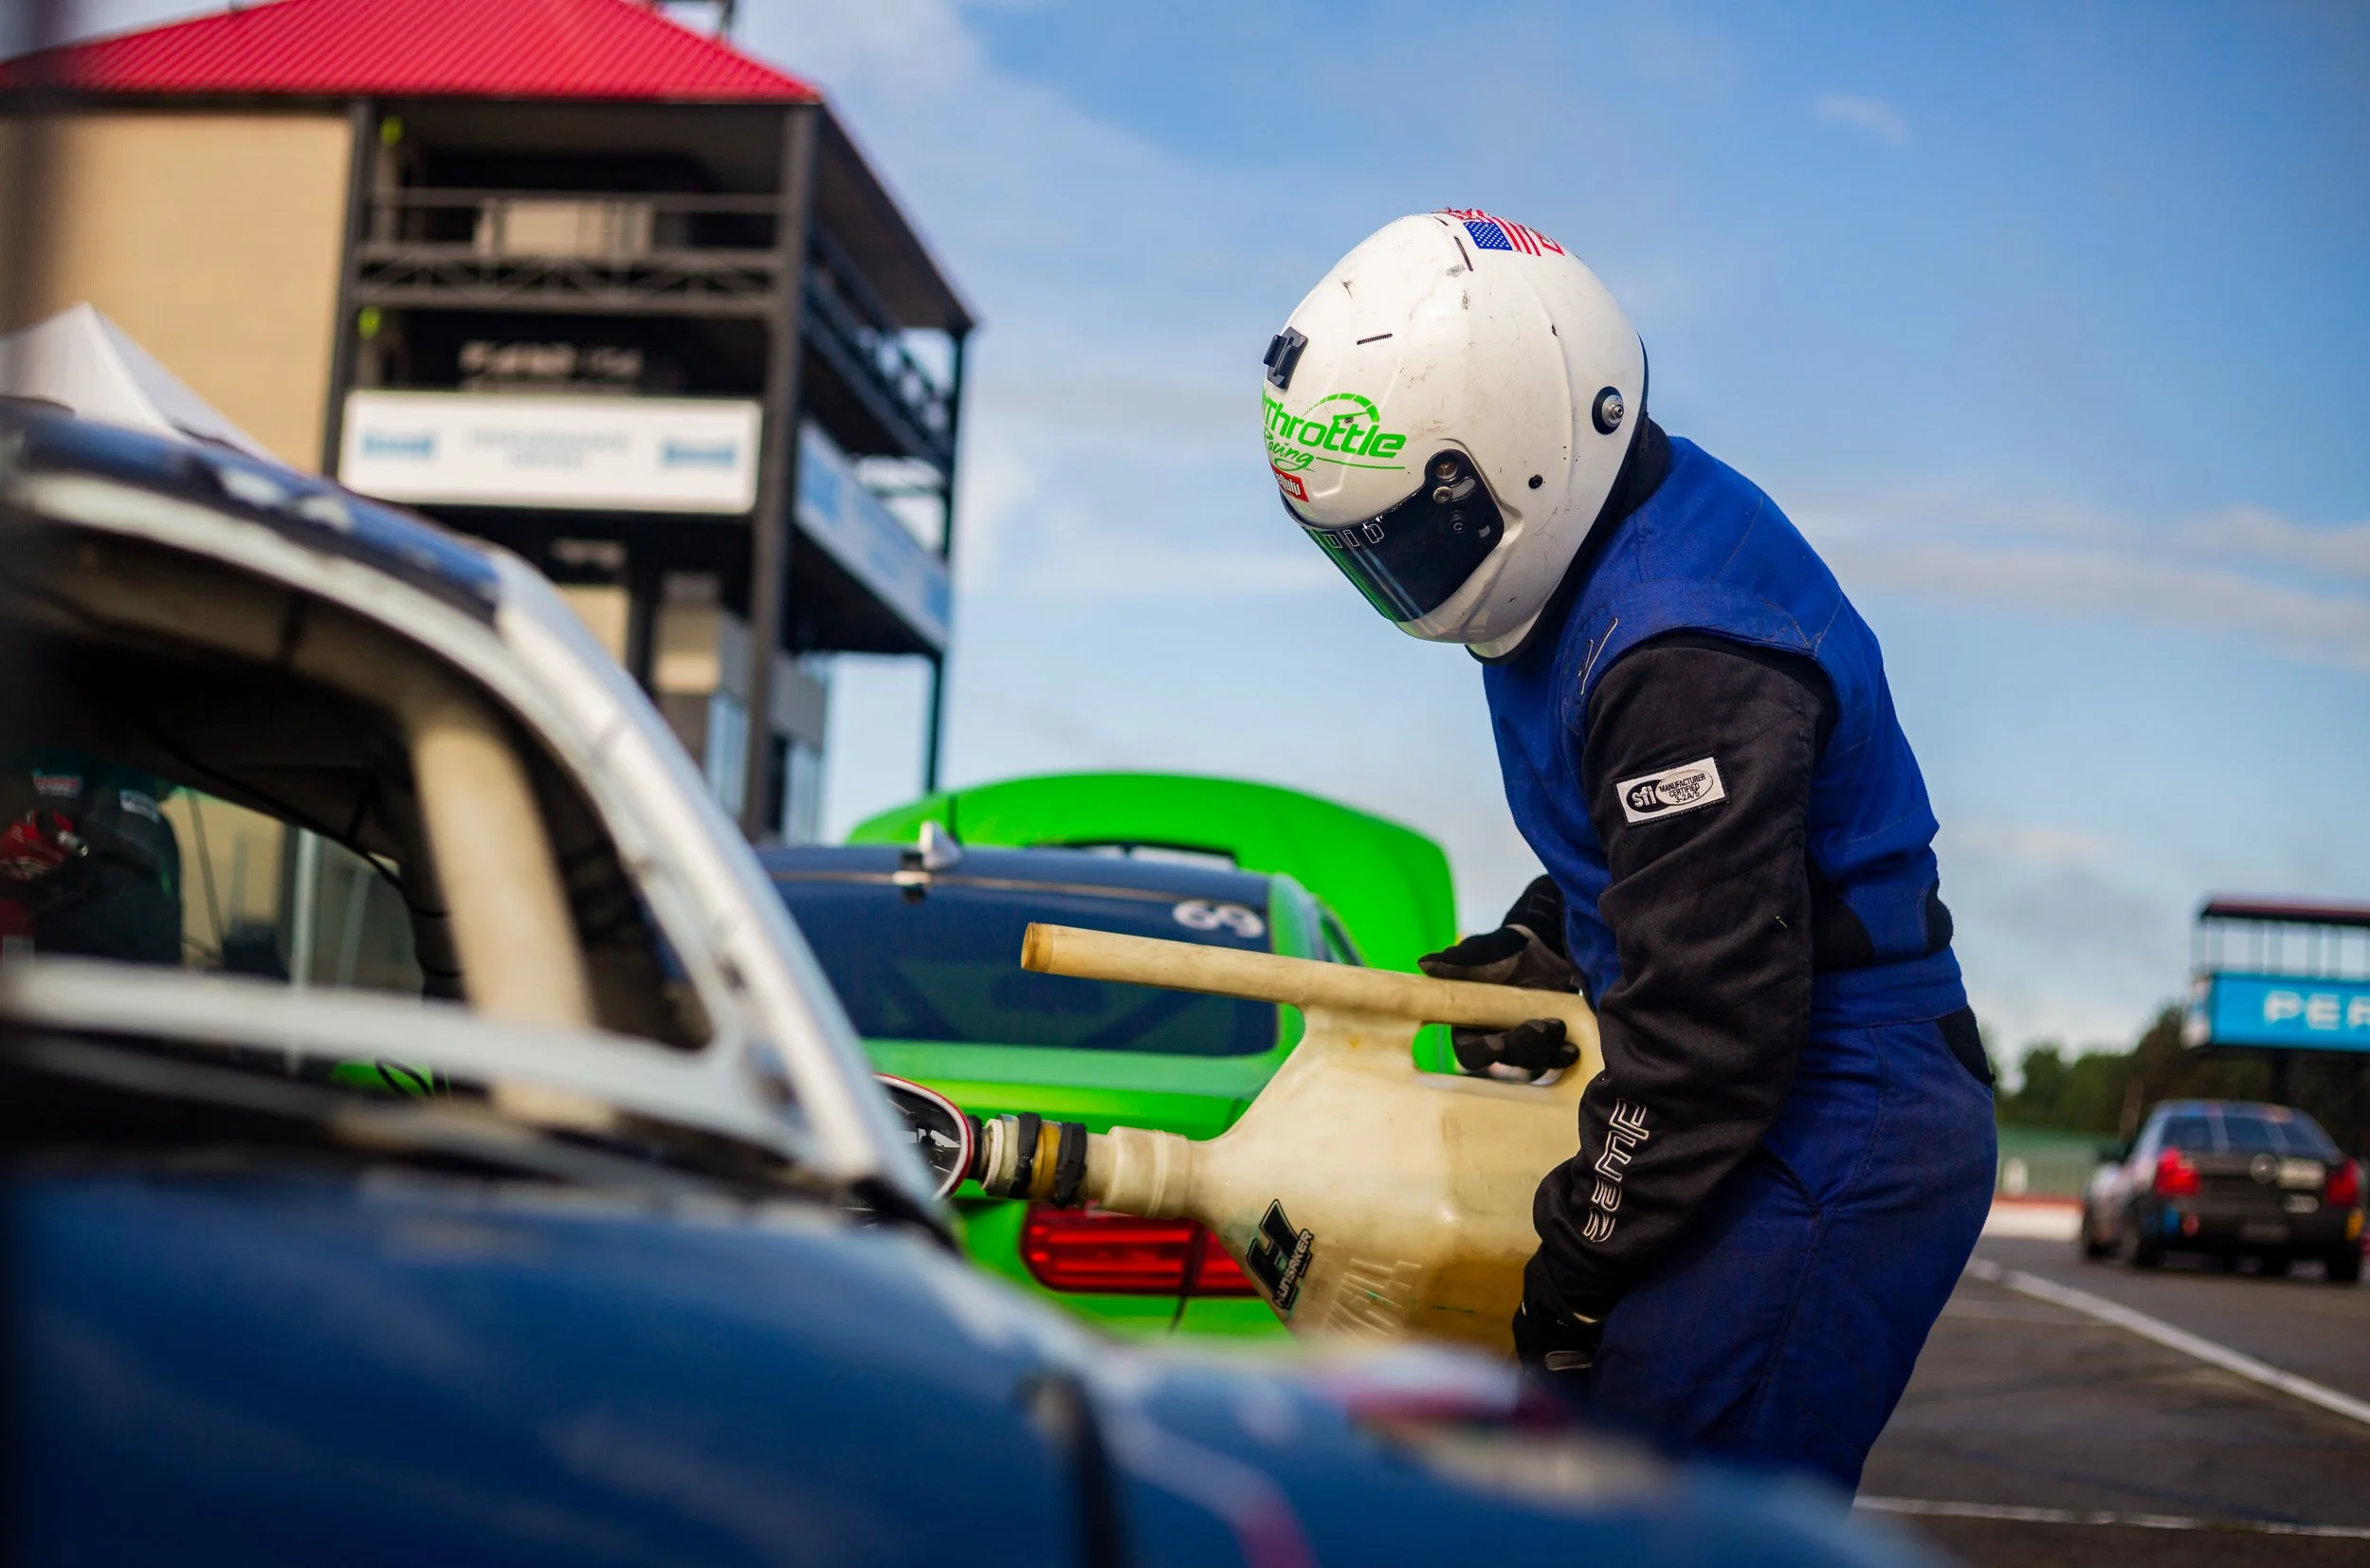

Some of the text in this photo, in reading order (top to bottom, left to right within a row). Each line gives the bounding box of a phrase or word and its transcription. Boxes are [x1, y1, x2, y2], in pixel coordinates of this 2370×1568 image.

[1262, 386, 1407, 459] Throttle
[1659, 774, 1705, 793] MANUFACTURER
[1668, 783, 1701, 798] CERTIFIED
[1632, 786, 1657, 808] sfi
[1675, 791, 1701, 803] 3-2A/5
[1276, 1231, 1314, 1307] HUNSAKER
